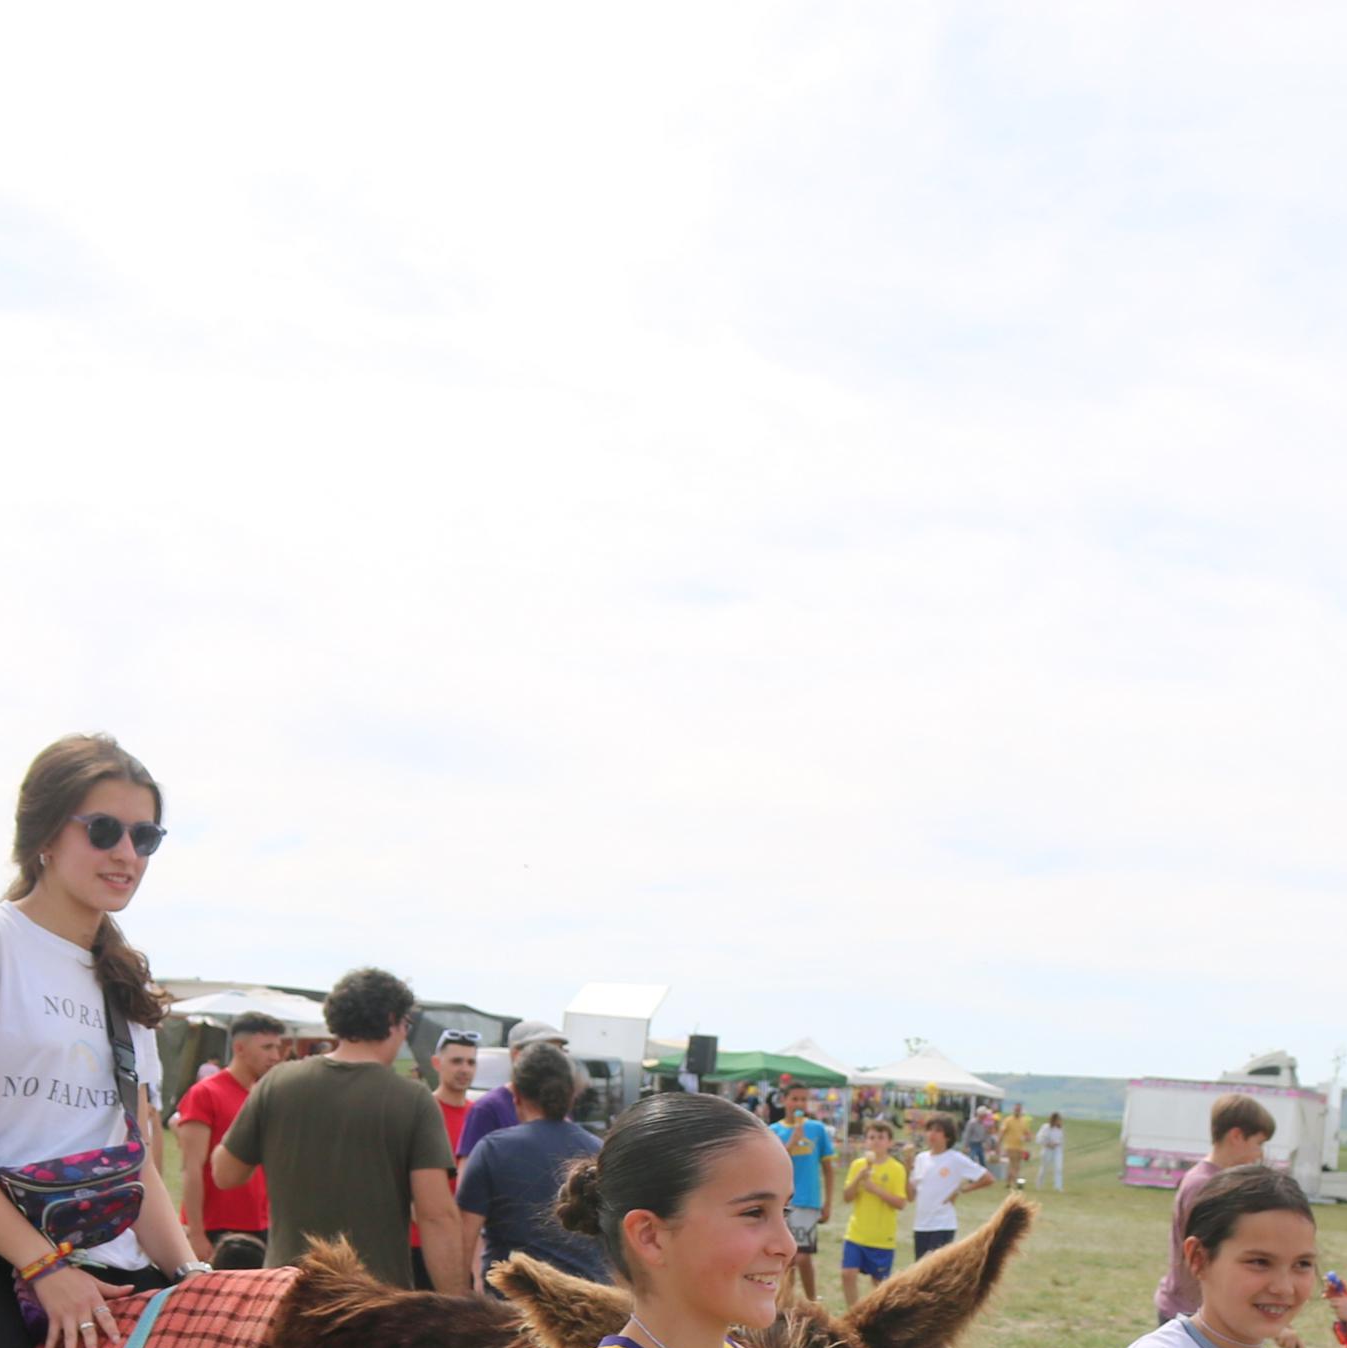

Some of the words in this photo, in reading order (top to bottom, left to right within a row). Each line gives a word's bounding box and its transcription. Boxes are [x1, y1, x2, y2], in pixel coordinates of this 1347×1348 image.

[42, 994, 75, 1019] NO
[79, 1004, 105, 1030] RA
[1, 1075, 40, 1098] NO
[47, 1078, 120, 1109] RAINB
